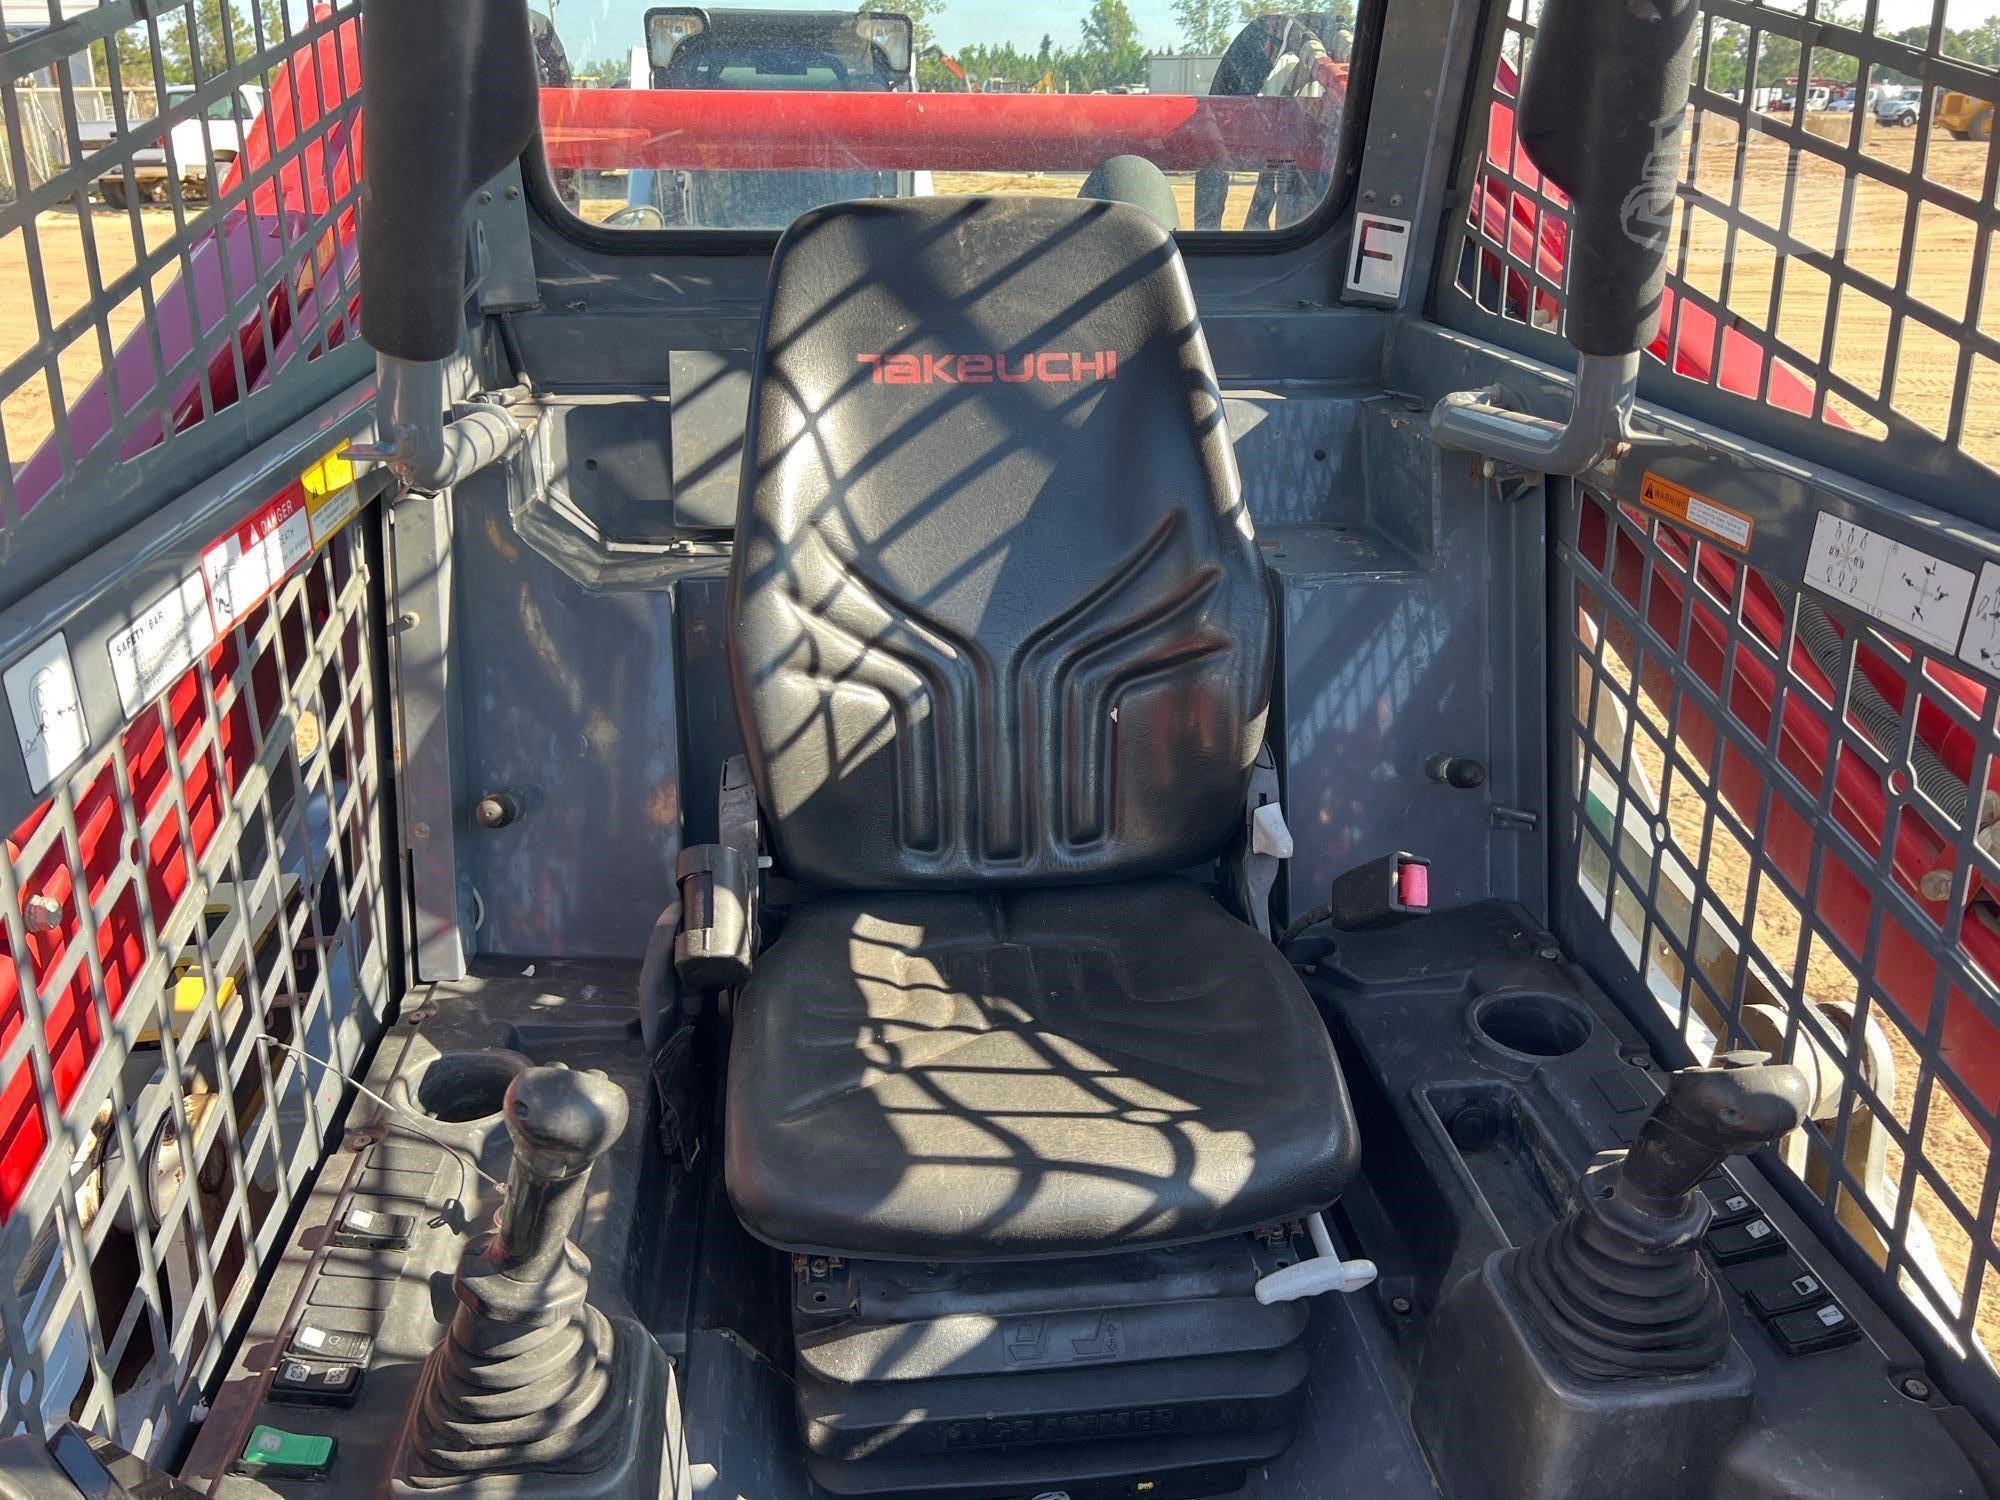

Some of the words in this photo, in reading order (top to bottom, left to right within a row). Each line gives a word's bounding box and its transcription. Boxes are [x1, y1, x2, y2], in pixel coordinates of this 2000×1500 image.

[1654, 487, 1687, 510] WARNING
[260, 499, 293, 534] DANGER
[116, 627, 145, 656] SAFETY
